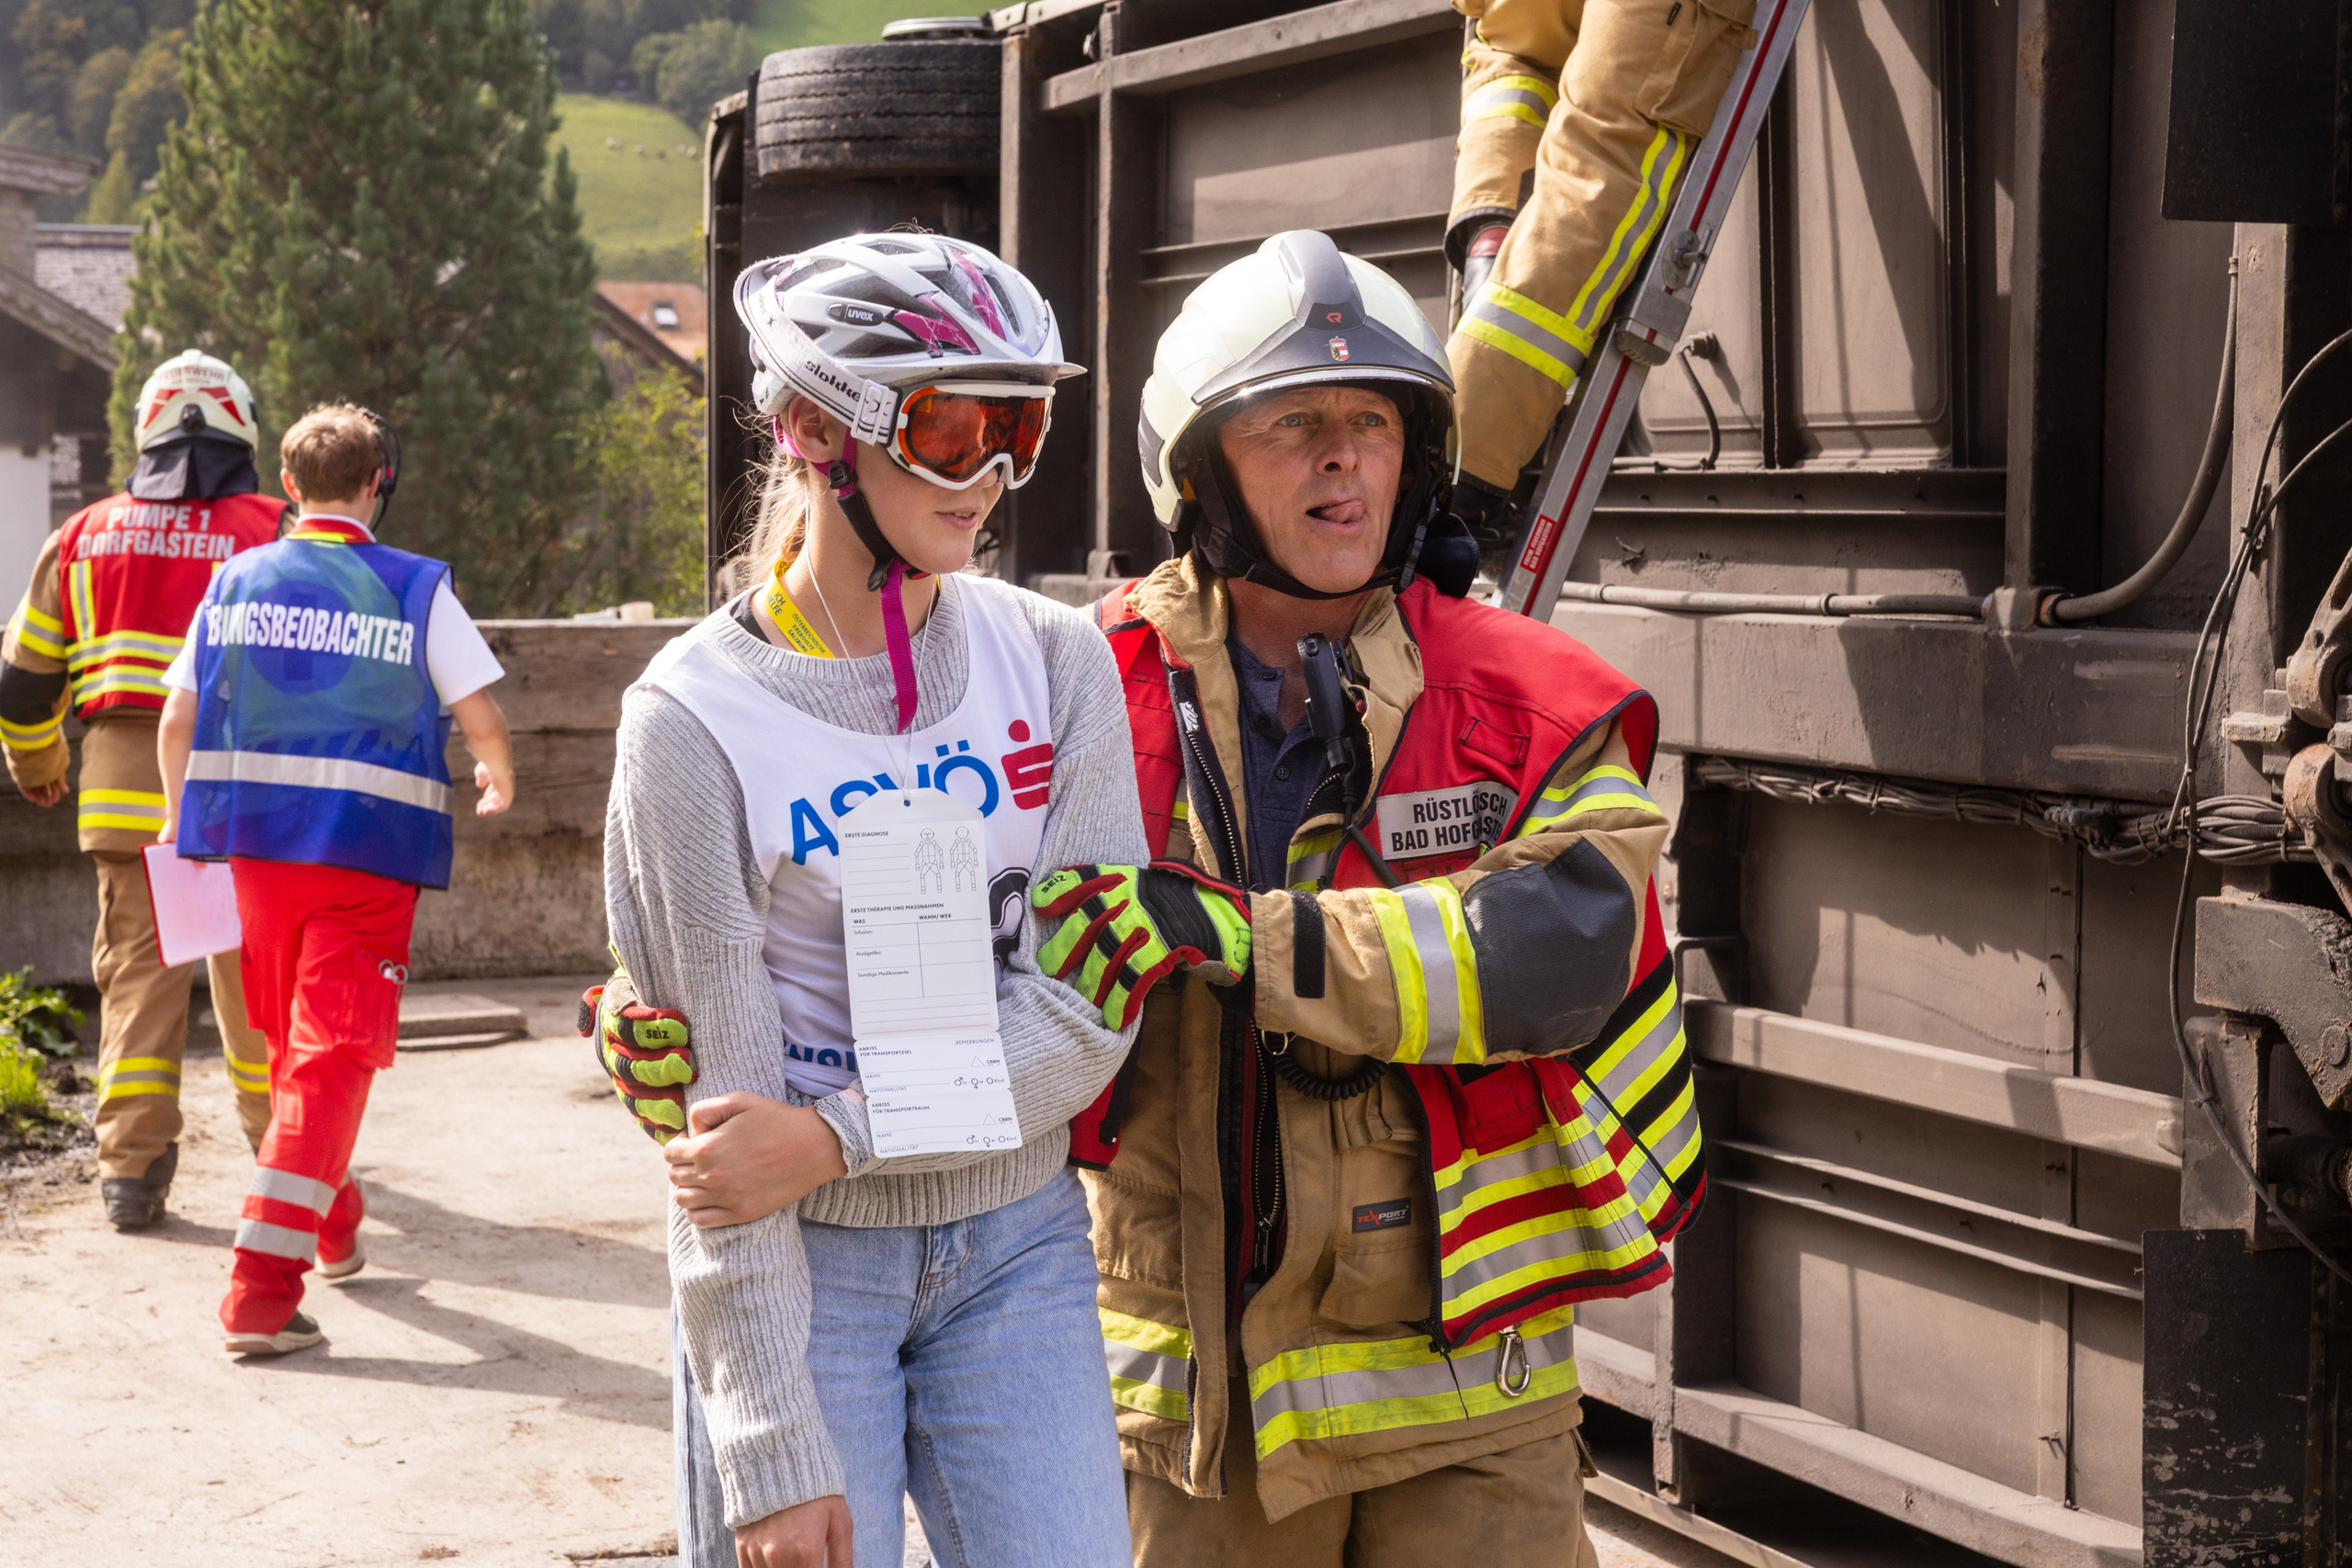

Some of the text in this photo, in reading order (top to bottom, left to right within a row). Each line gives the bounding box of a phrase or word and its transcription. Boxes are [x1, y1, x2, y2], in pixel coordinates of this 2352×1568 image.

[848, 309, 874, 321] uvex
[106, 503, 211, 532] PUMPE 1
[77, 529, 236, 560] DORFGASTEIN
[767, 594, 783, 616] HELFE
[774, 592, 786, 606] ICH
[787, 629, 808, 653] SALZBURG
[792, 613, 826, 654] ÖSTERREICHISCHE
[792, 625, 815, 650] KREBSHILFE
[790, 739, 999, 865] AÖ
[1413, 790, 1508, 823] RÜSTLÖSCH
[1392, 829, 1429, 852] BAD
[1357, 1209, 1407, 1225] TEXPORT
